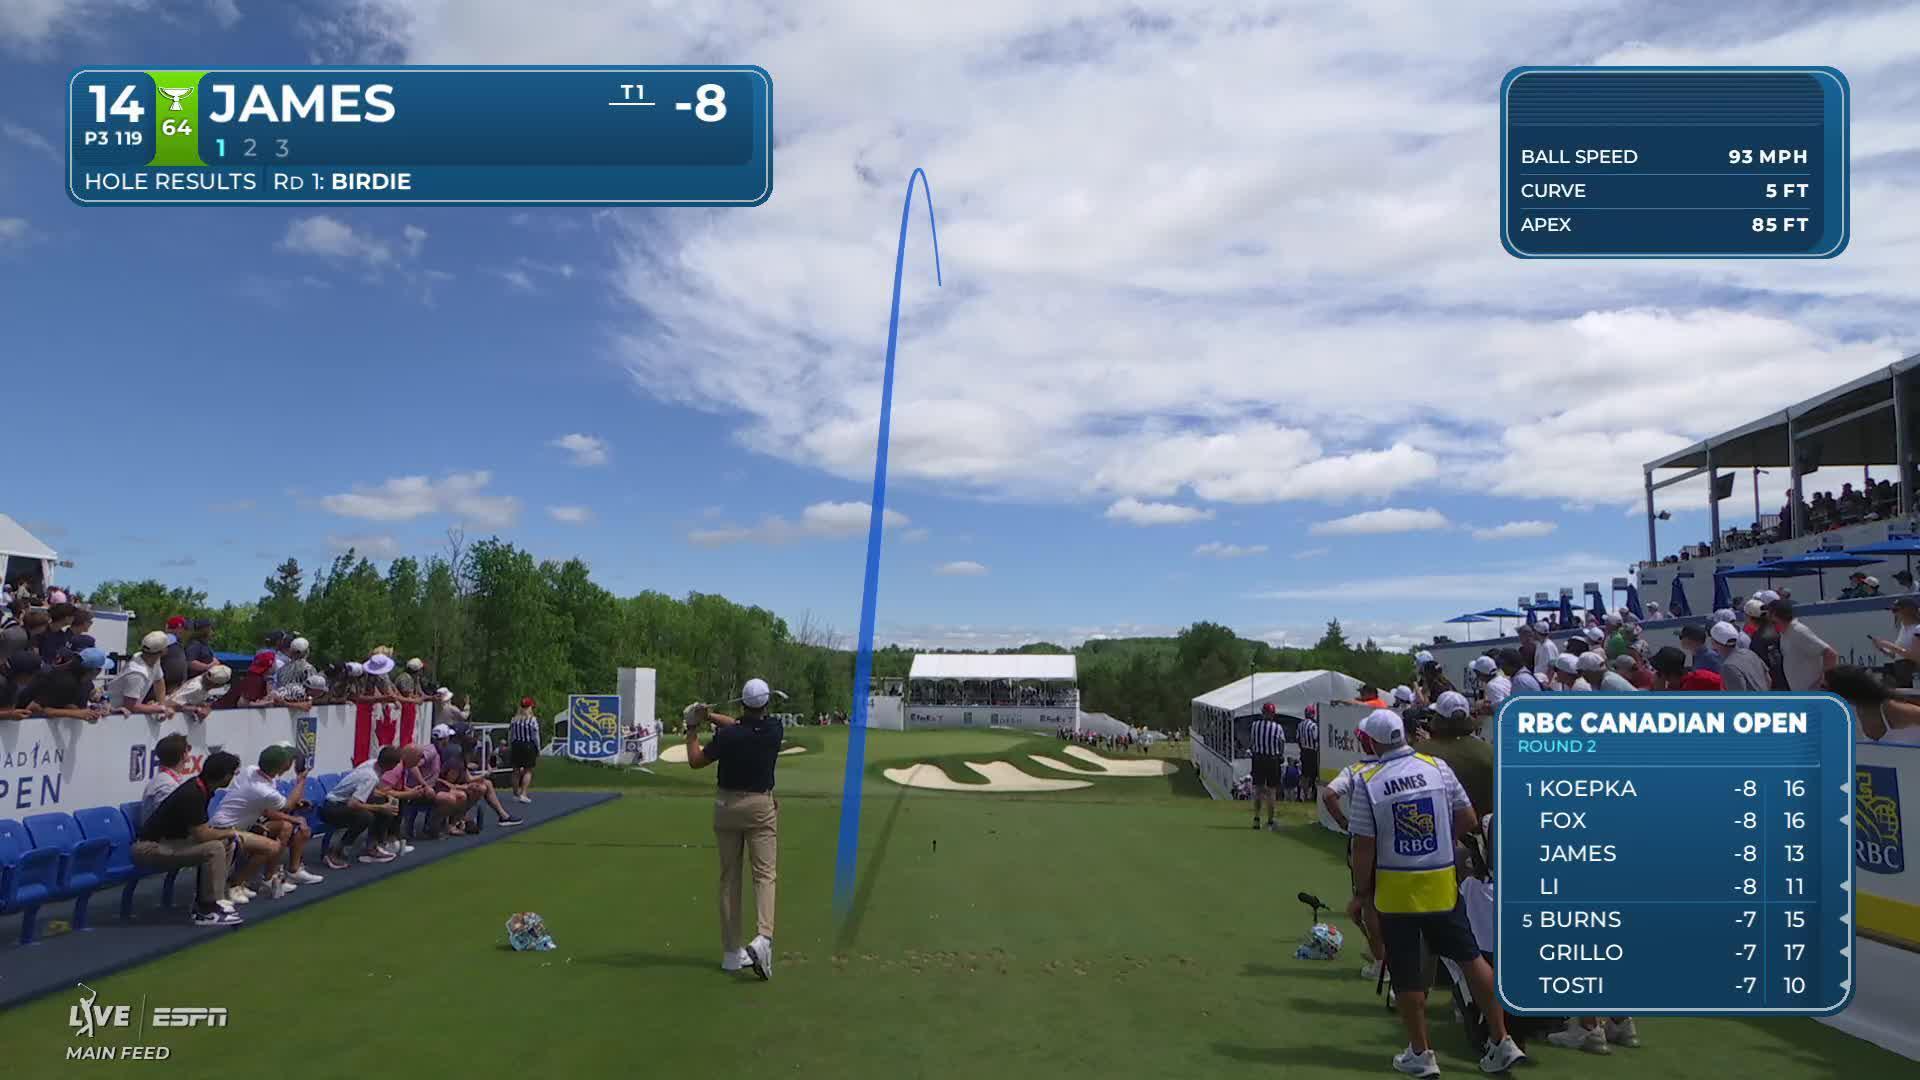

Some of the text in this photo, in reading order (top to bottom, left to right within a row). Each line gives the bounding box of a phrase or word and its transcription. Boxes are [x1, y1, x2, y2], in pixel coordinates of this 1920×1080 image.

[0, 742, 64, 769] ADIAN
[574, 740, 616, 755] RBC
[1383, 774, 1427, 796] JAMES
[1399, 836, 1435, 853] RBC
